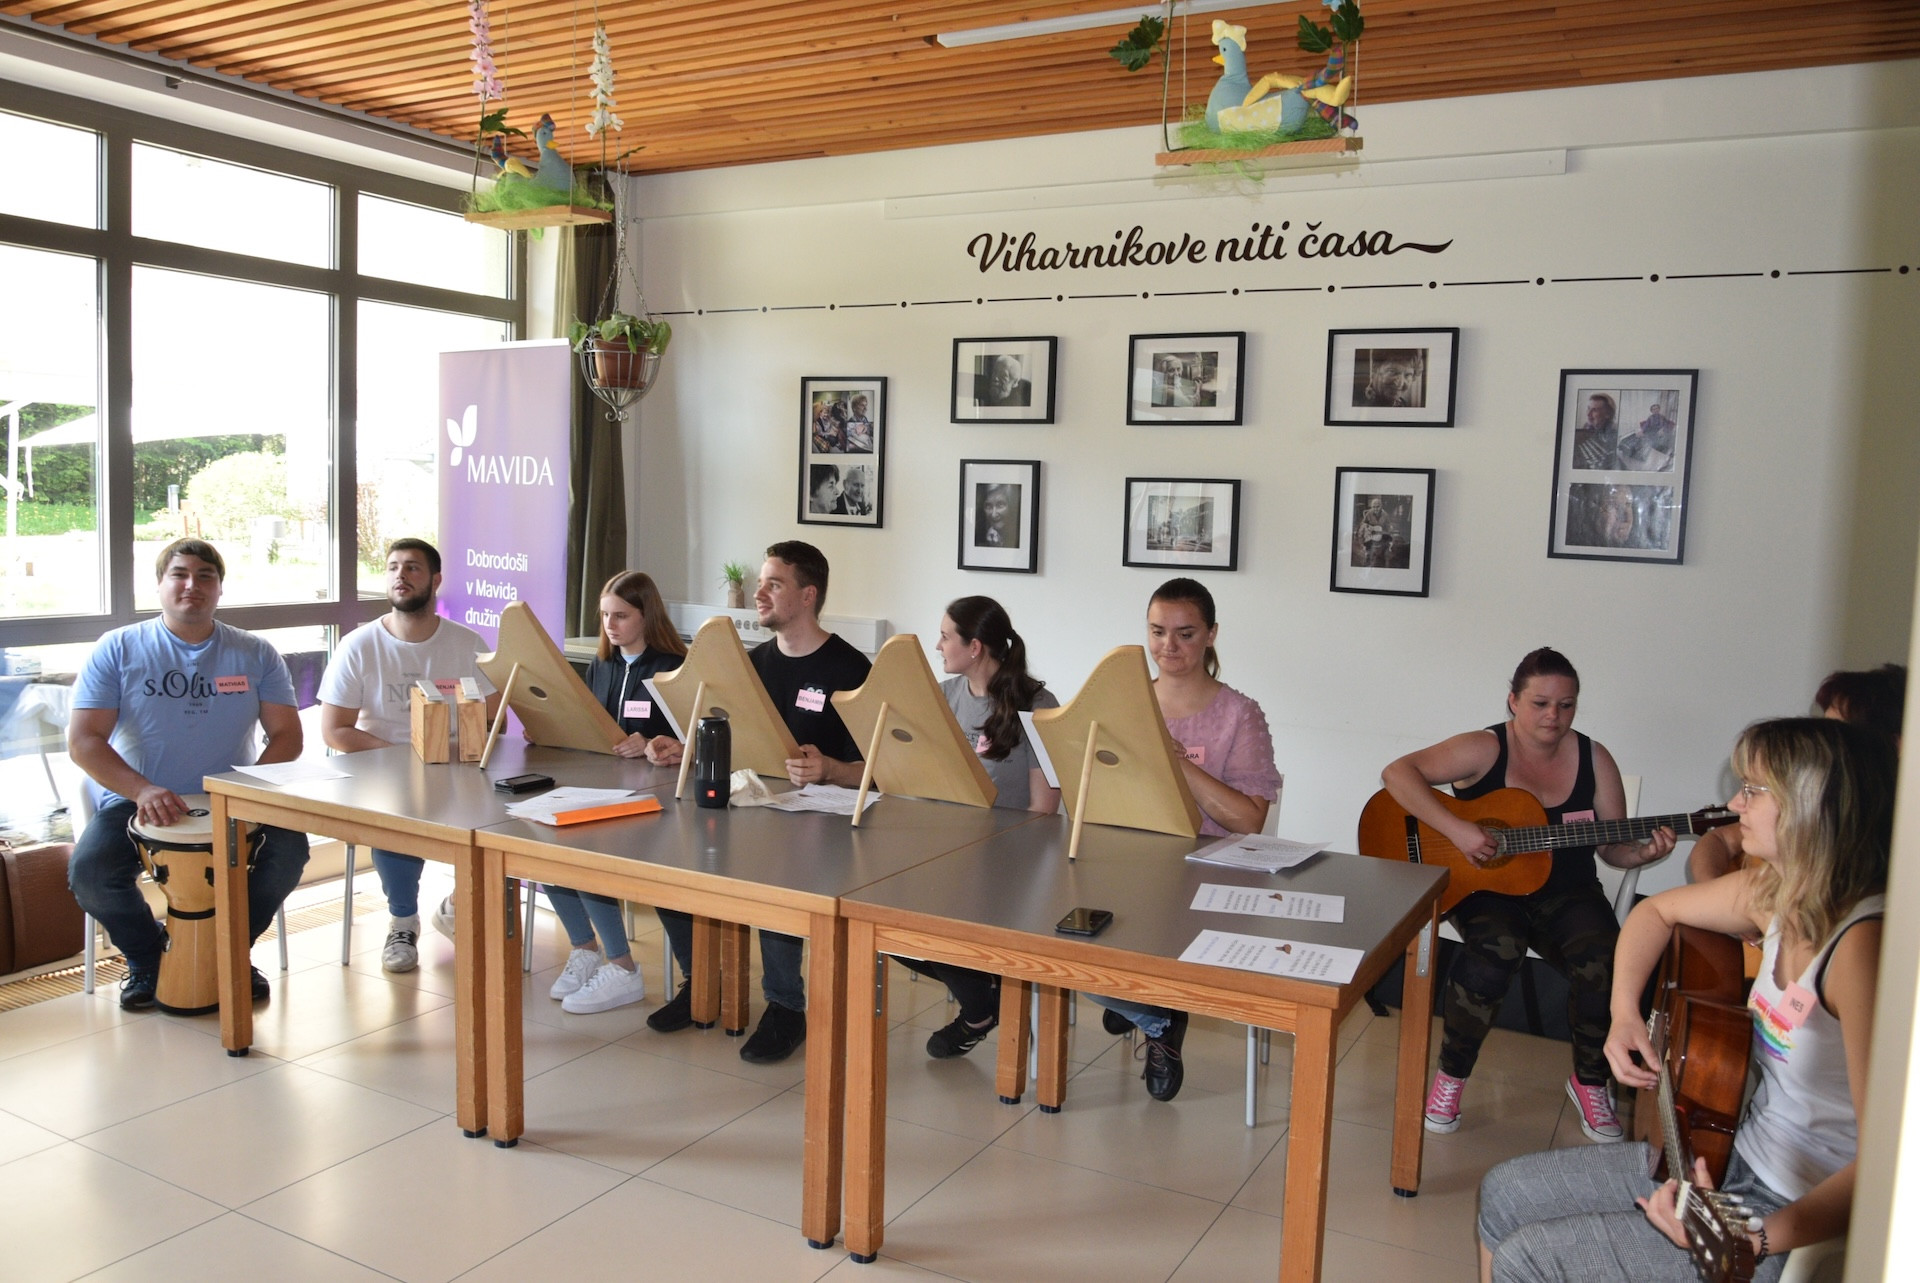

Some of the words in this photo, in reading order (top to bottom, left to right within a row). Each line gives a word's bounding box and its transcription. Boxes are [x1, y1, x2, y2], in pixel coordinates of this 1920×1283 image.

[967, 225, 1207, 273] Viharnikove
[1214, 220, 1288, 264] niti
[1298, 221, 1454, 258] časa
[467, 454, 554, 486] MAVIDA
[466, 548, 529, 573] Dobrodošli
[466, 580, 474, 595] v
[475, 578, 518, 601] Mavida
[465, 606, 502, 629] družin
[143, 669, 246, 699] s.Oliv
[218, 680, 246, 688] MATHIAS
